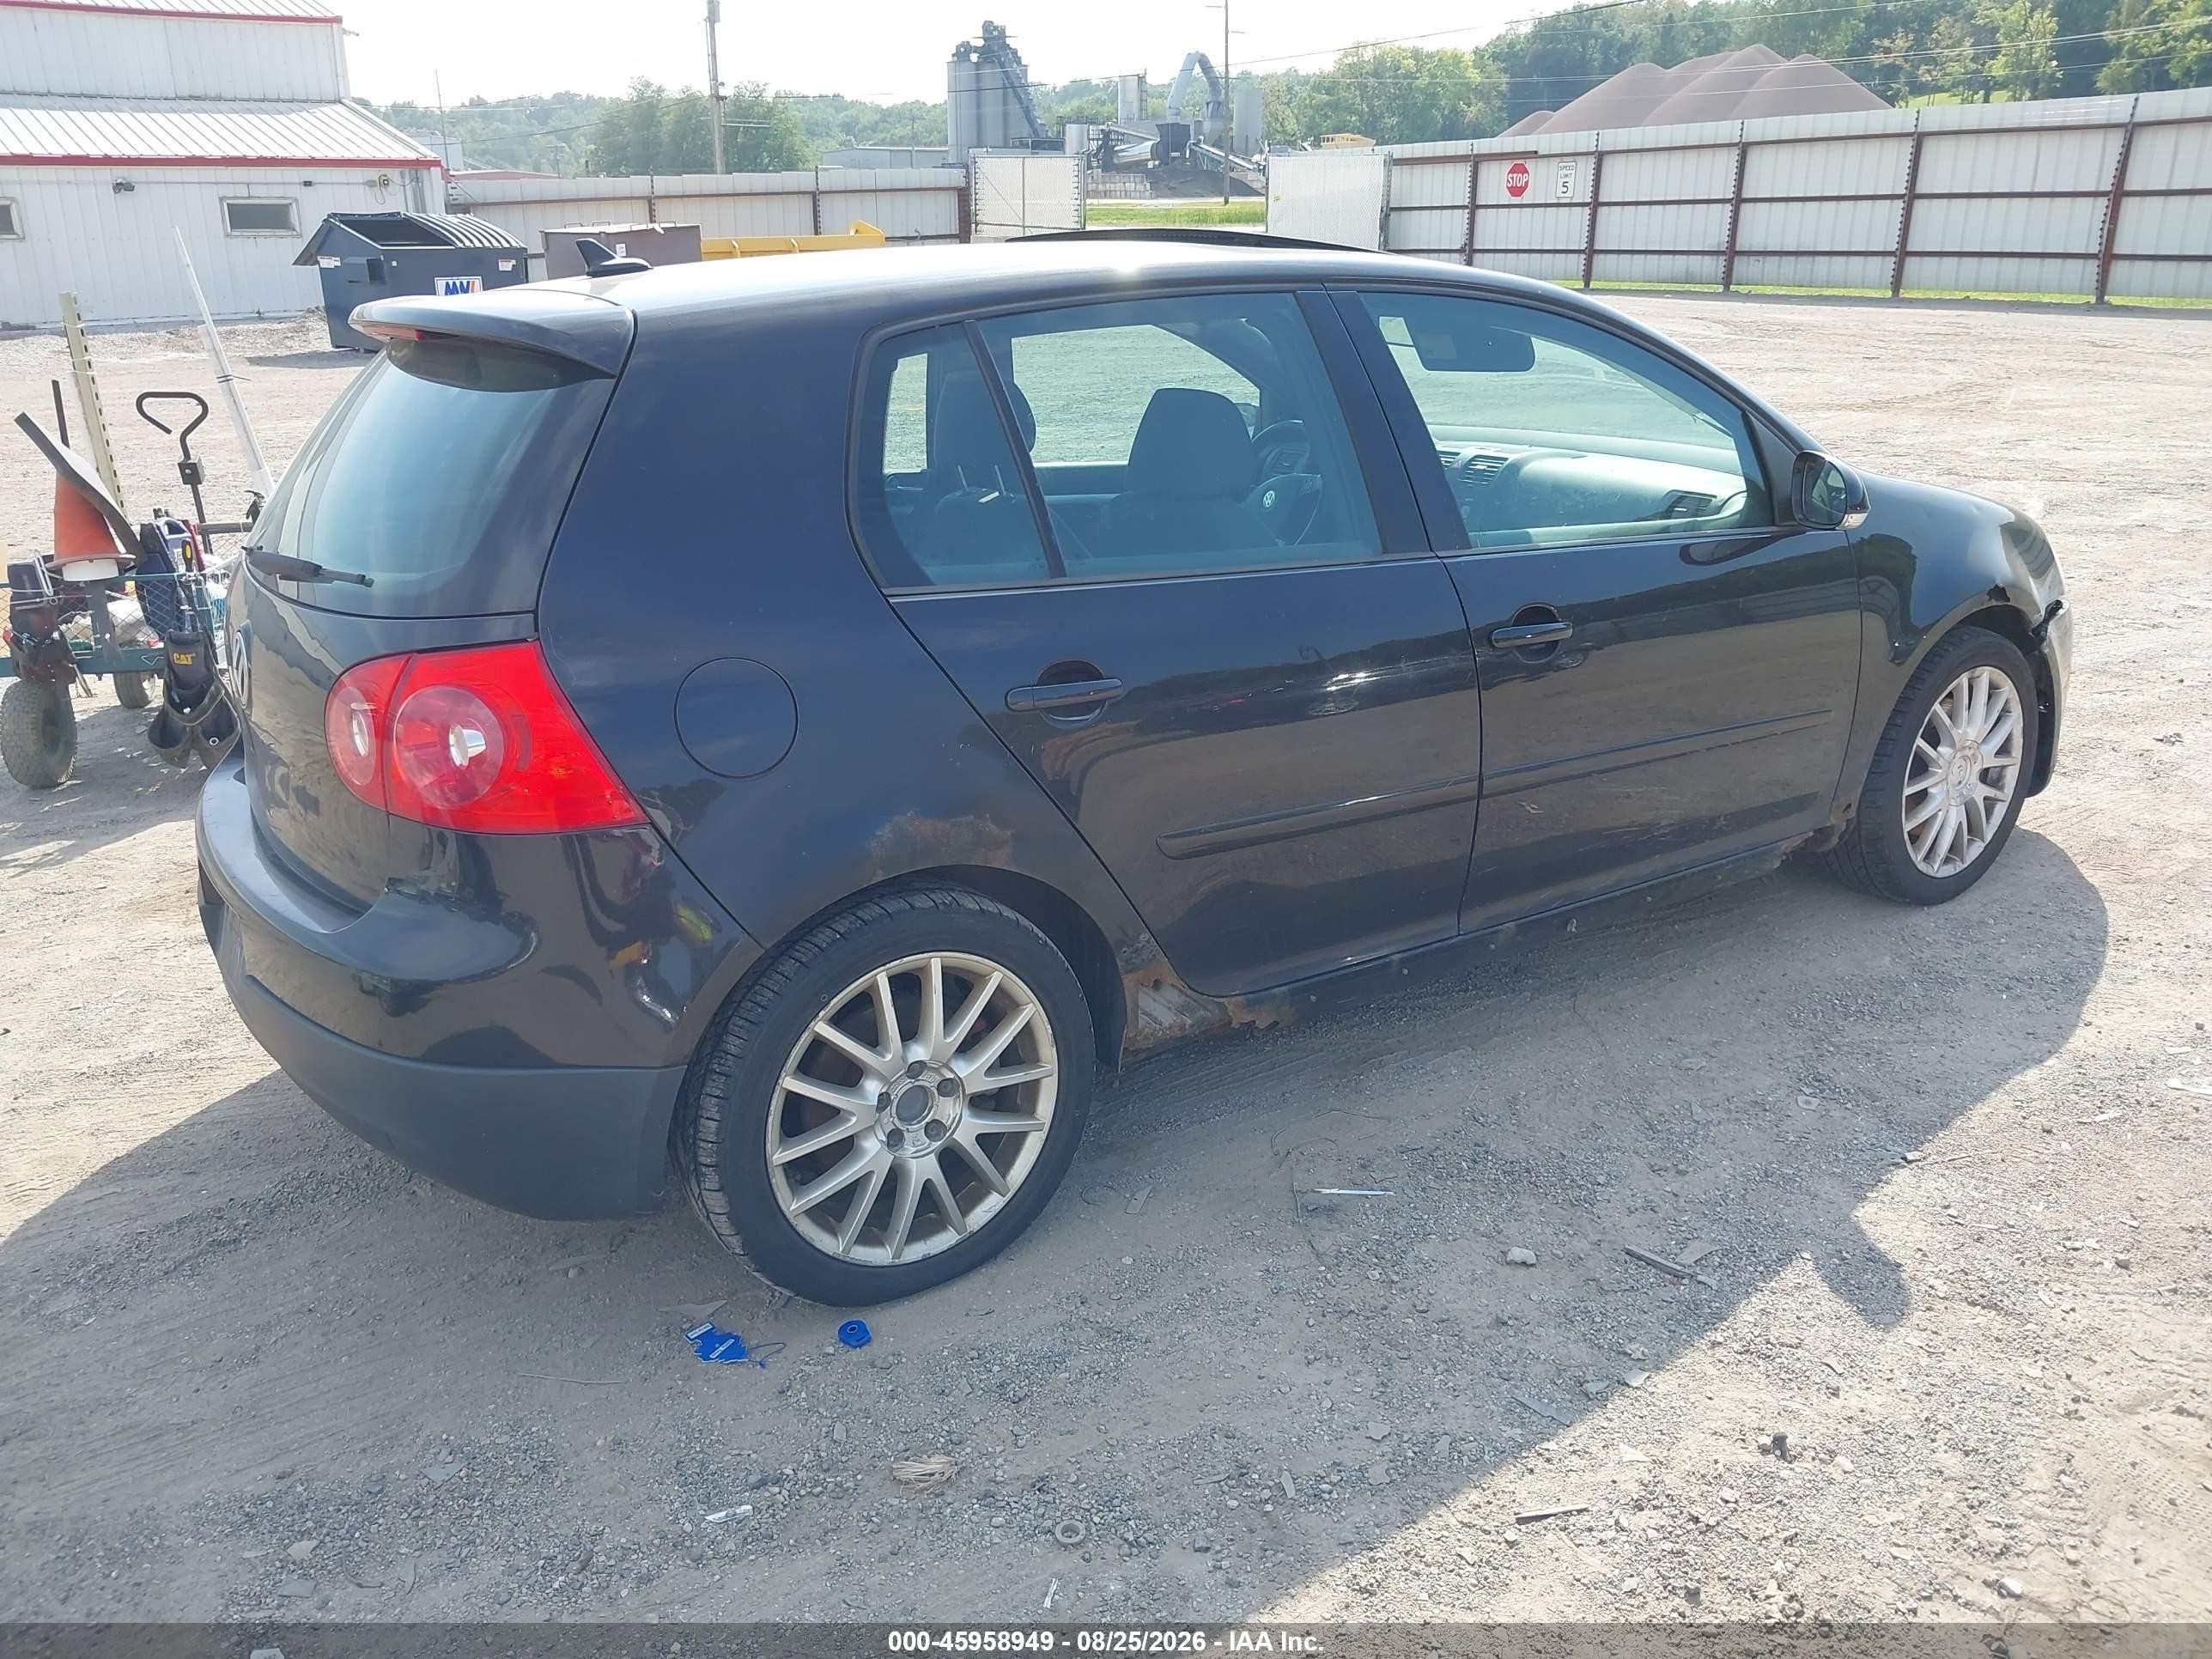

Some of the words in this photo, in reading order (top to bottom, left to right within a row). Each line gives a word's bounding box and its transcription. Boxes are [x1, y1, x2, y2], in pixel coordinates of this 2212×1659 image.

[1507, 173, 1528, 187] STOP
[1561, 181, 1569, 194] 5
[173, 653, 192, 665] CAT
